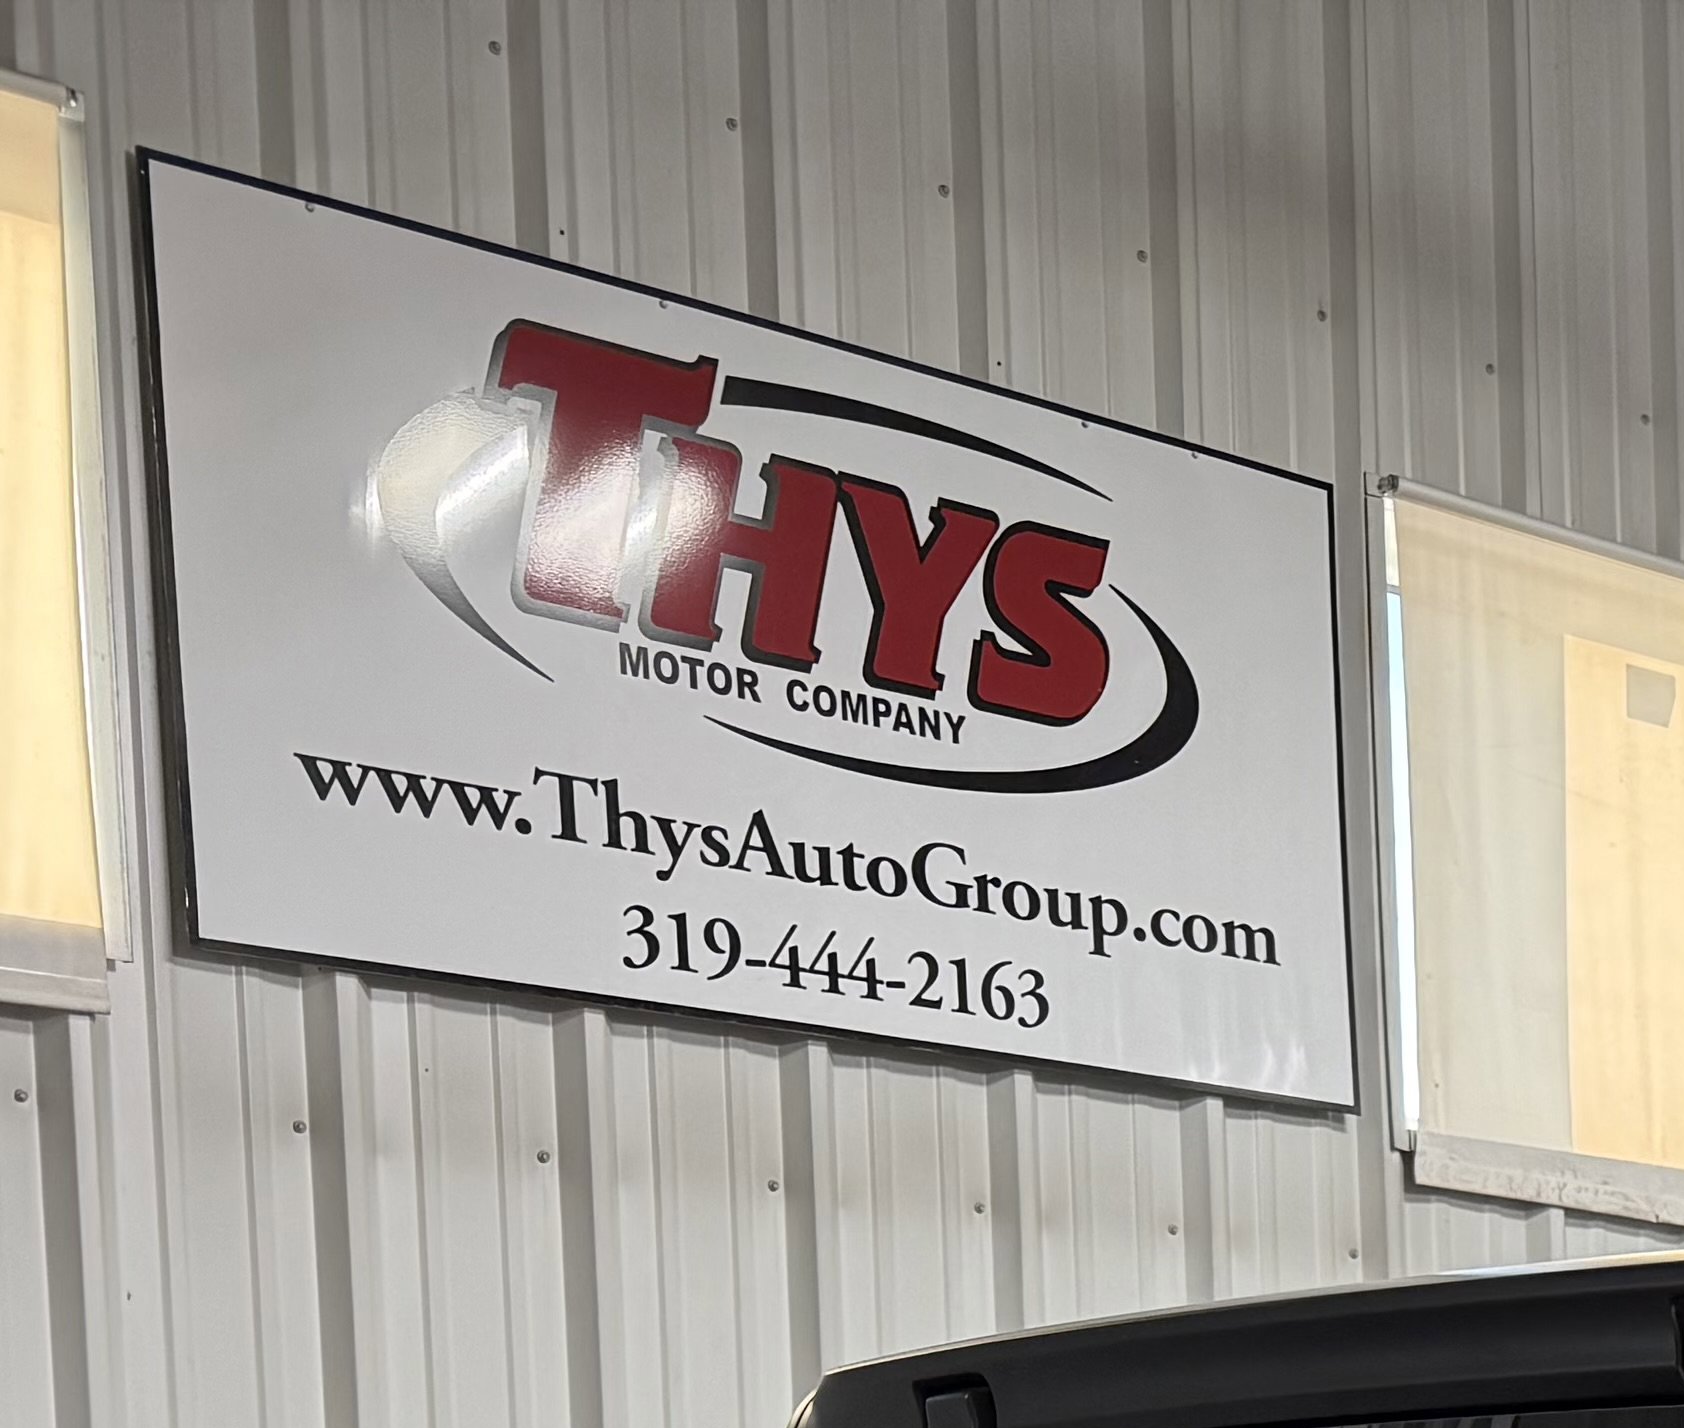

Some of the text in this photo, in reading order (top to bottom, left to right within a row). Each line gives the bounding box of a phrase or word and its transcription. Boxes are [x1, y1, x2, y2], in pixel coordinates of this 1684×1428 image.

[484, 318, 1112, 728] THYS
[617, 641, 967, 746] MOTOR COMPANY
[292, 750, 1283, 969] www.ThysAutoGroup.com
[620, 904, 1052, 1030] 319-444-2163
